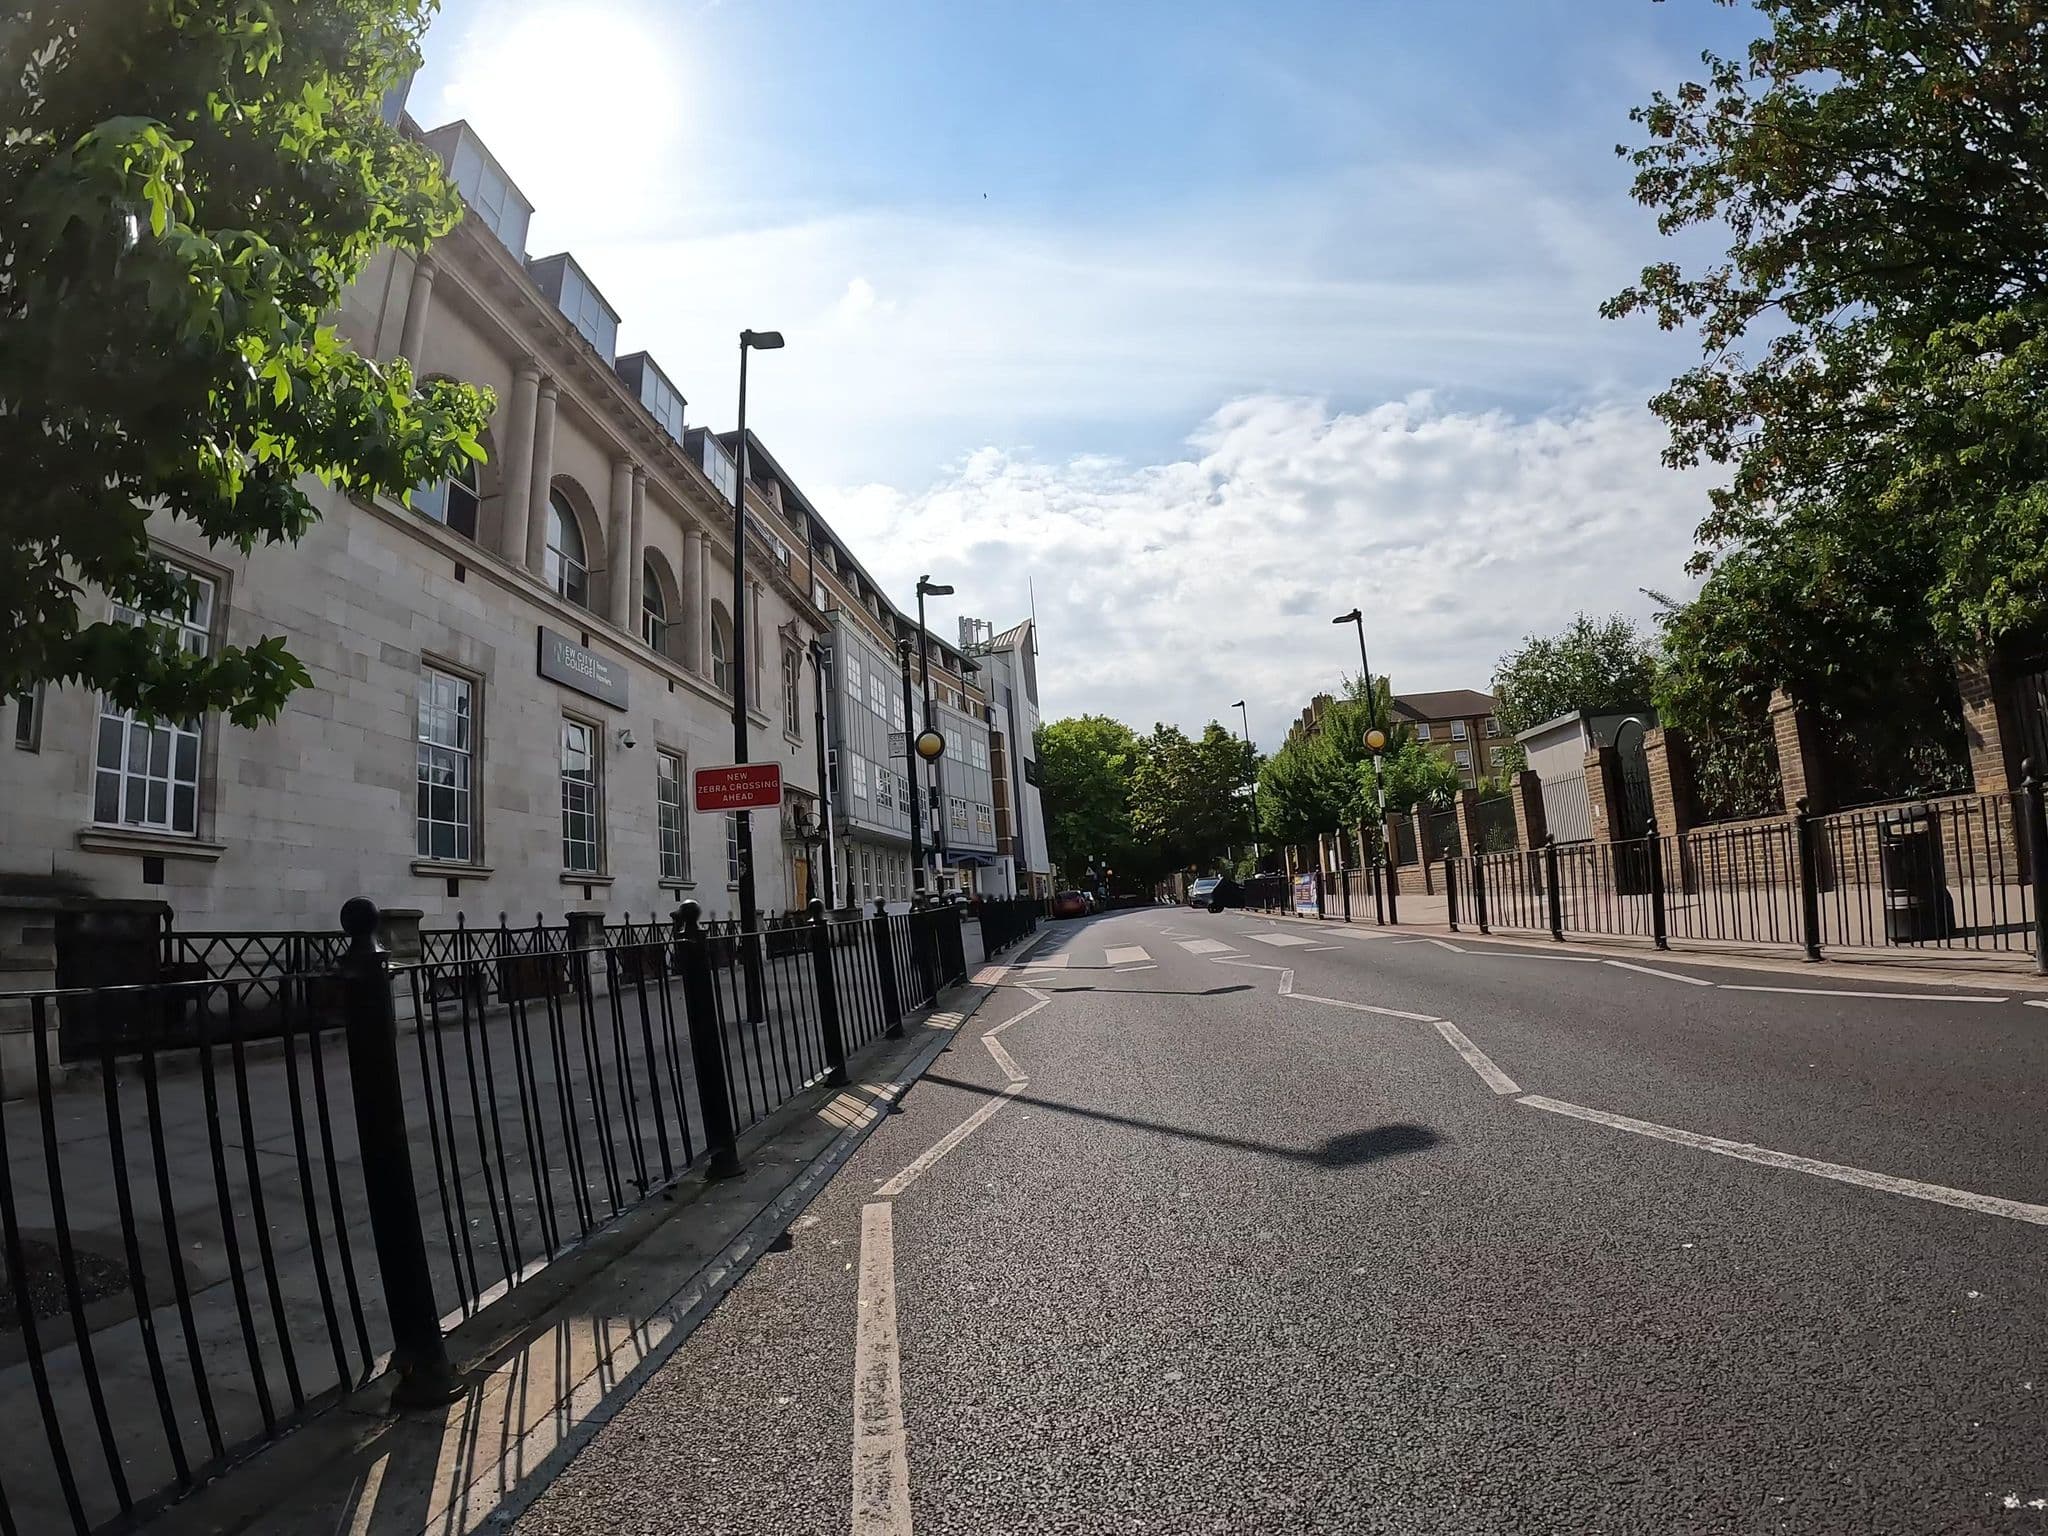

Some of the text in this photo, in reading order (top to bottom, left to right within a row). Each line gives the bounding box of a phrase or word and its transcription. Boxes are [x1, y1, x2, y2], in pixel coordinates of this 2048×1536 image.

[565, 656, 593, 677] COLLEGE
[577, 652, 593, 668] CITY
[727, 772, 747, 781] NEW
[697, 780, 778, 794] ZEBRA CROSSING
[722, 793, 753, 802] AHEAD
